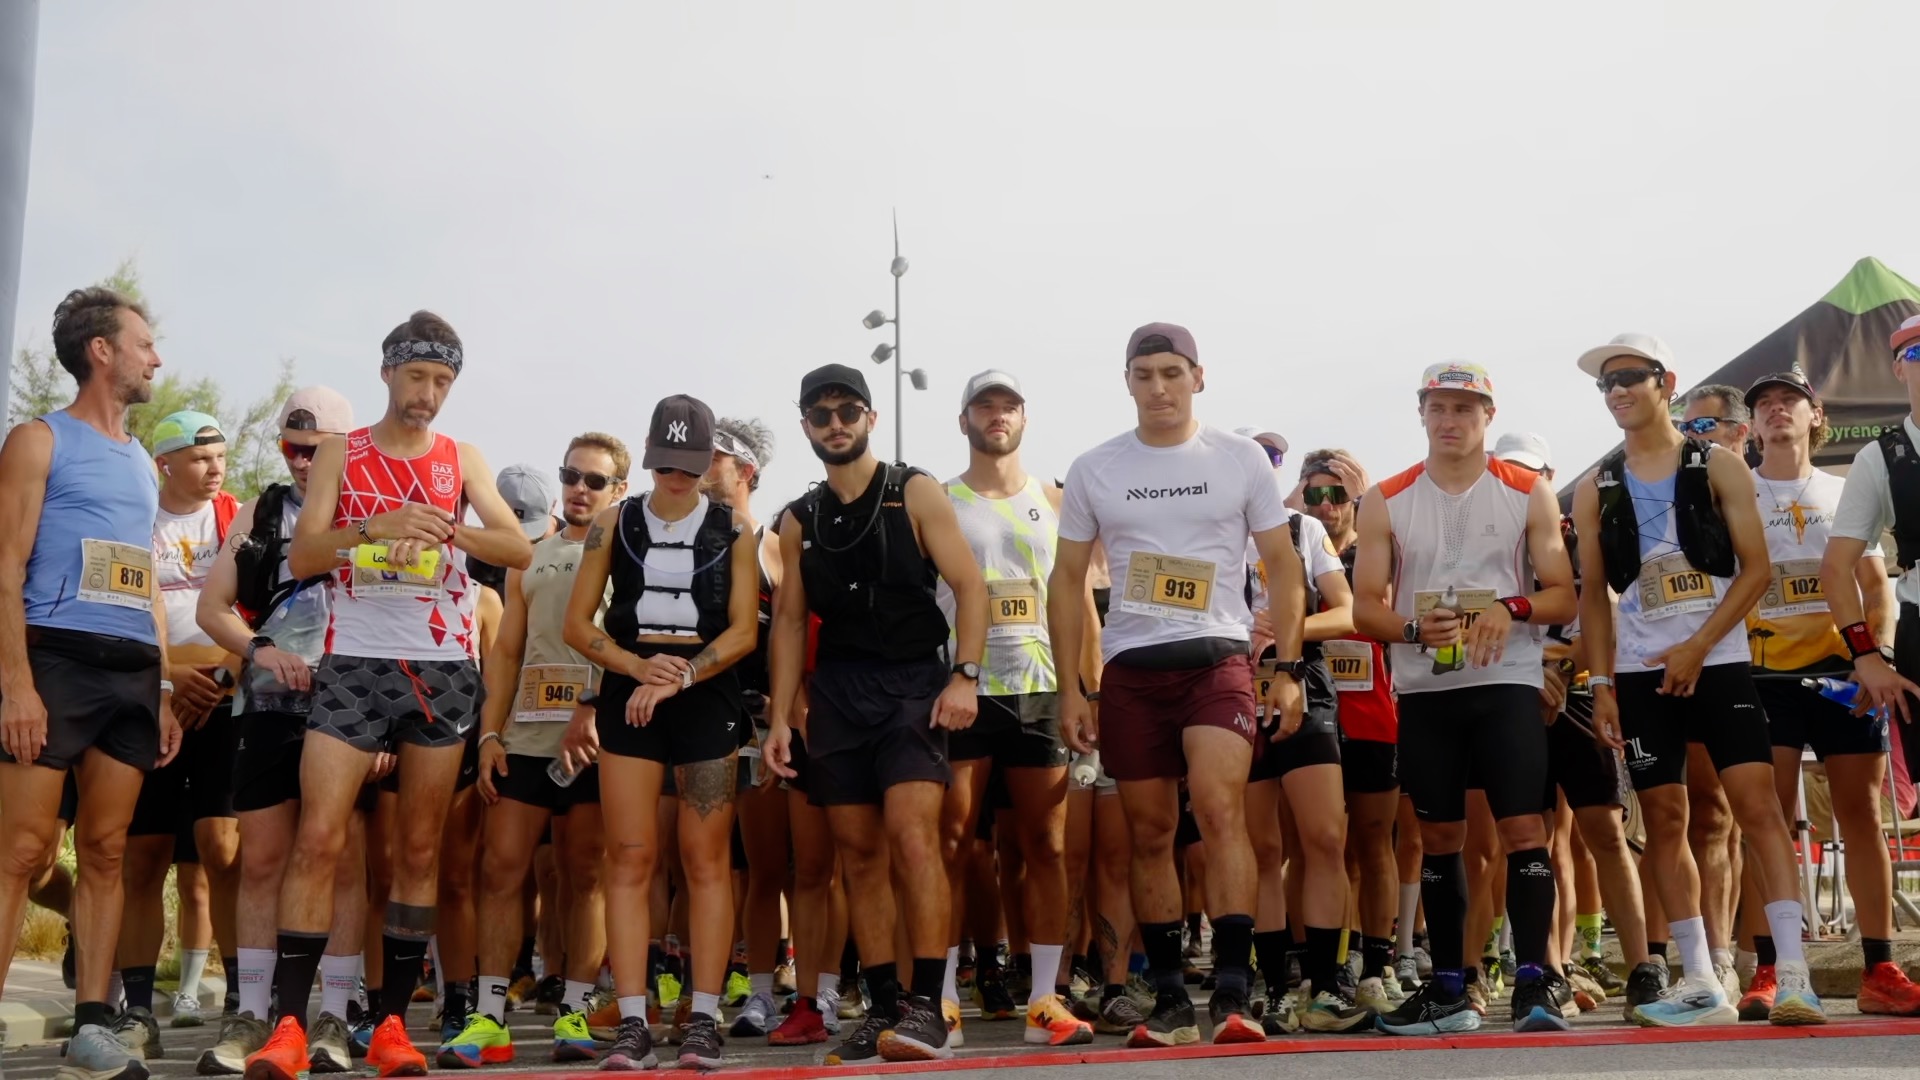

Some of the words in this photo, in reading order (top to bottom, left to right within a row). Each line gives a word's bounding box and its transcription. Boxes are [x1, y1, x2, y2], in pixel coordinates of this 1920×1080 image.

[431, 464, 454, 475] DAX
[120, 566, 144, 588] 878
[1668, 573, 1705, 594] 1037
[1789, 577, 1823, 595] 102
[1164, 578, 1196, 600] 913
[1000, 599, 1028, 617] 879
[1330, 658, 1361, 674] 1077
[544, 684, 575, 702] 946
